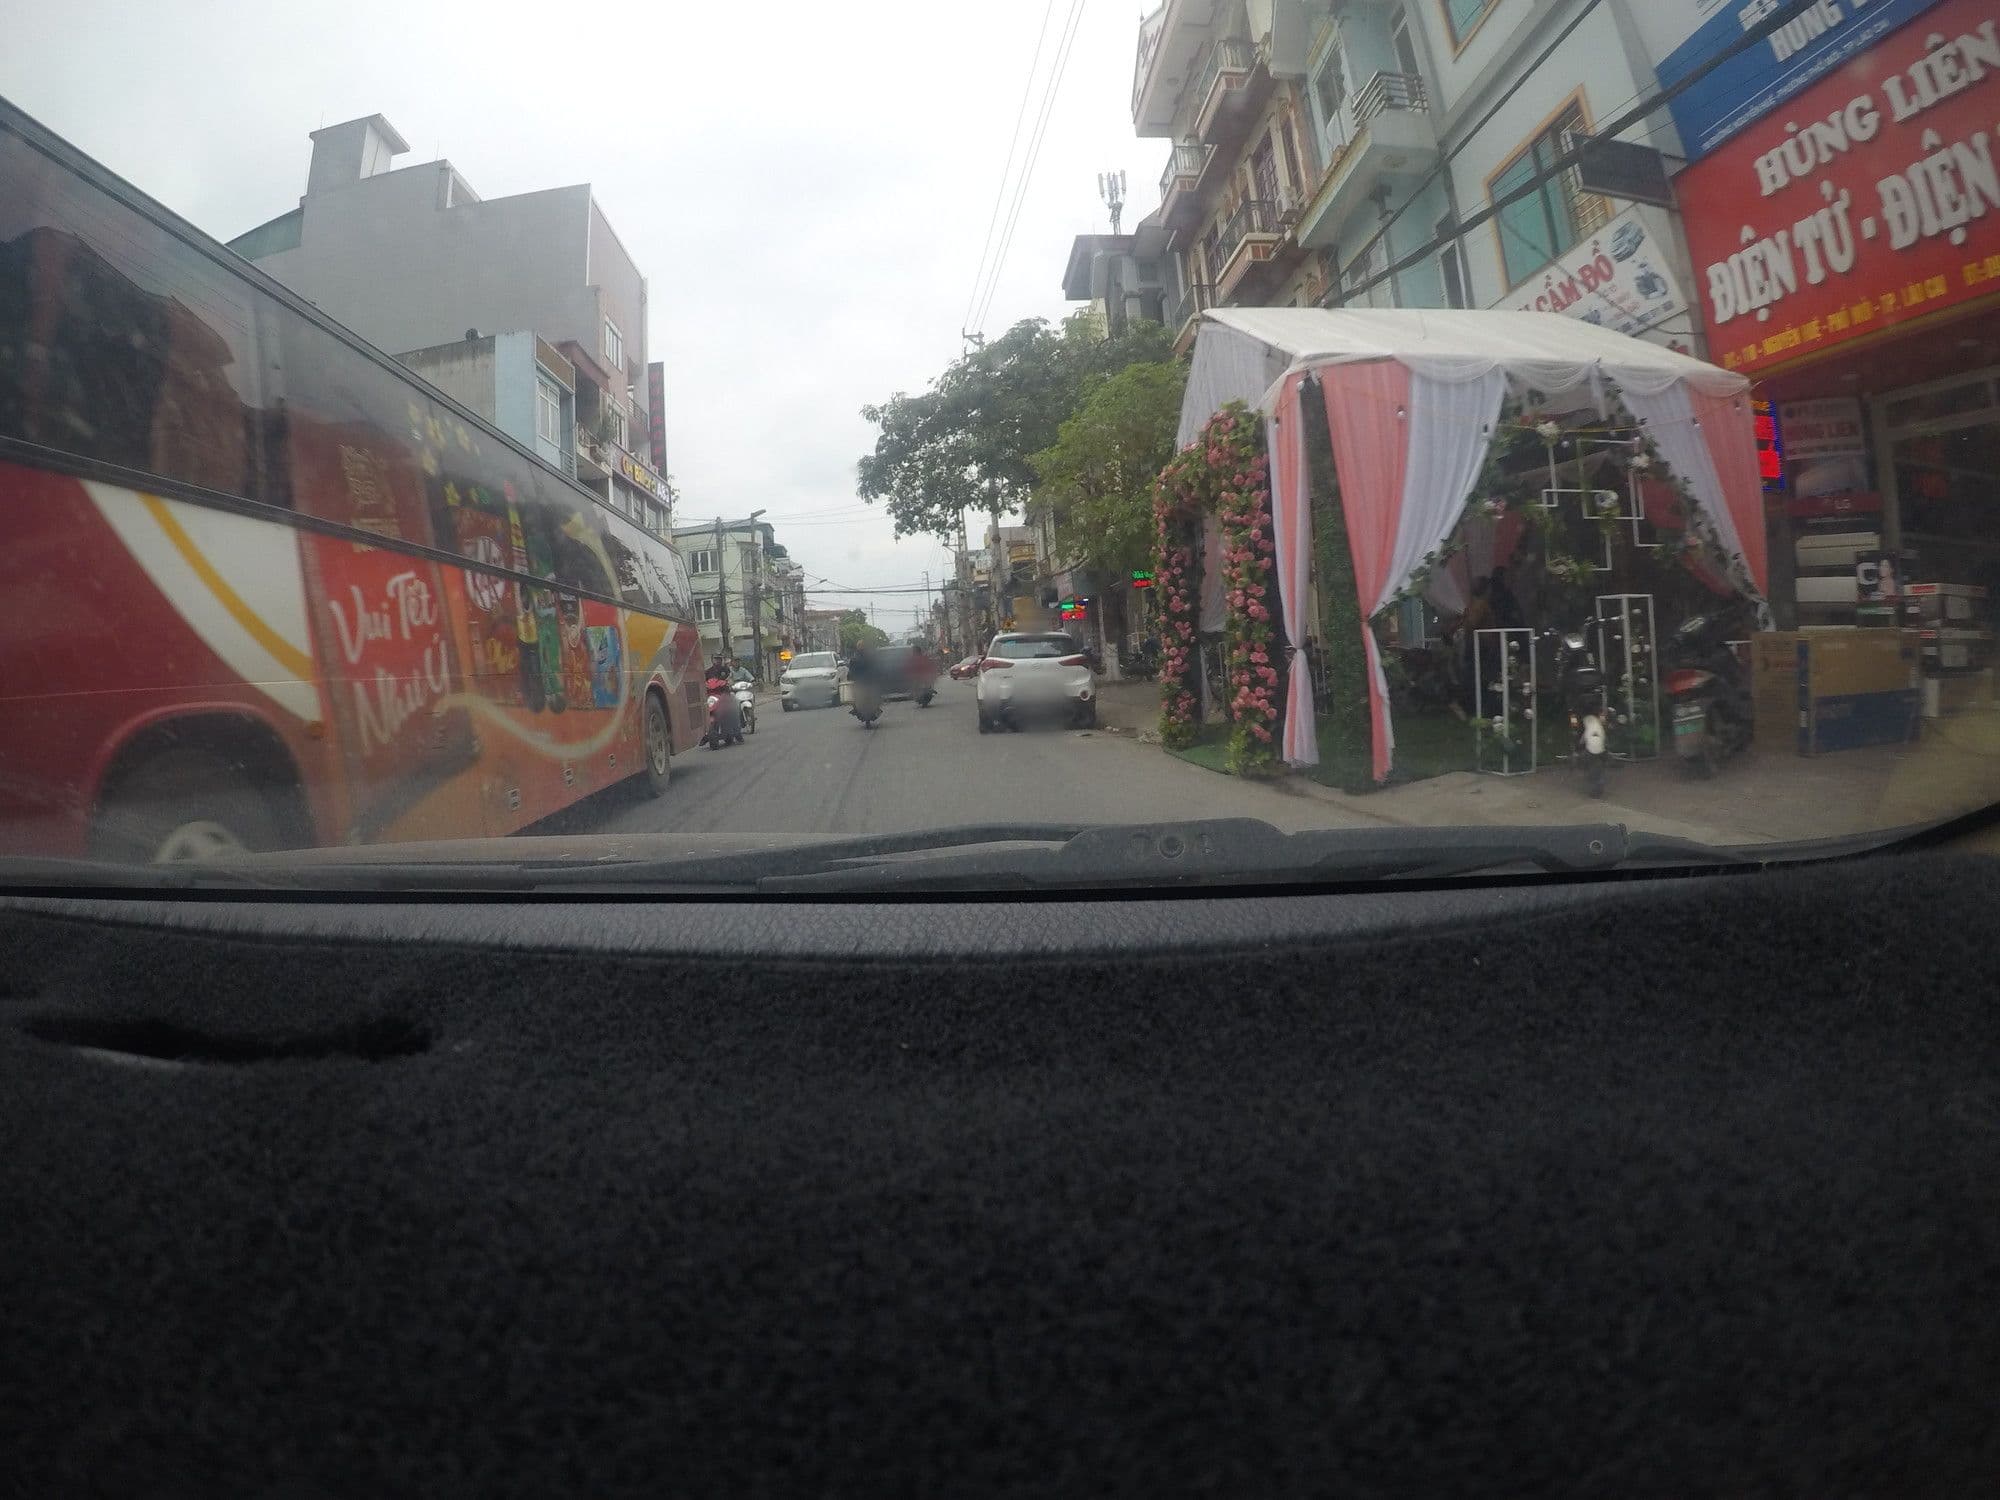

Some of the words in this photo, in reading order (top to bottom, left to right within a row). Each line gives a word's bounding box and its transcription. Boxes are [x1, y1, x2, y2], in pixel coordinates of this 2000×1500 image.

[1705, 225, 1799, 324] ĐIỆN
[1793, 179, 1857, 285] TỬ
[1875, 127, 2000, 250] ĐIỆN
